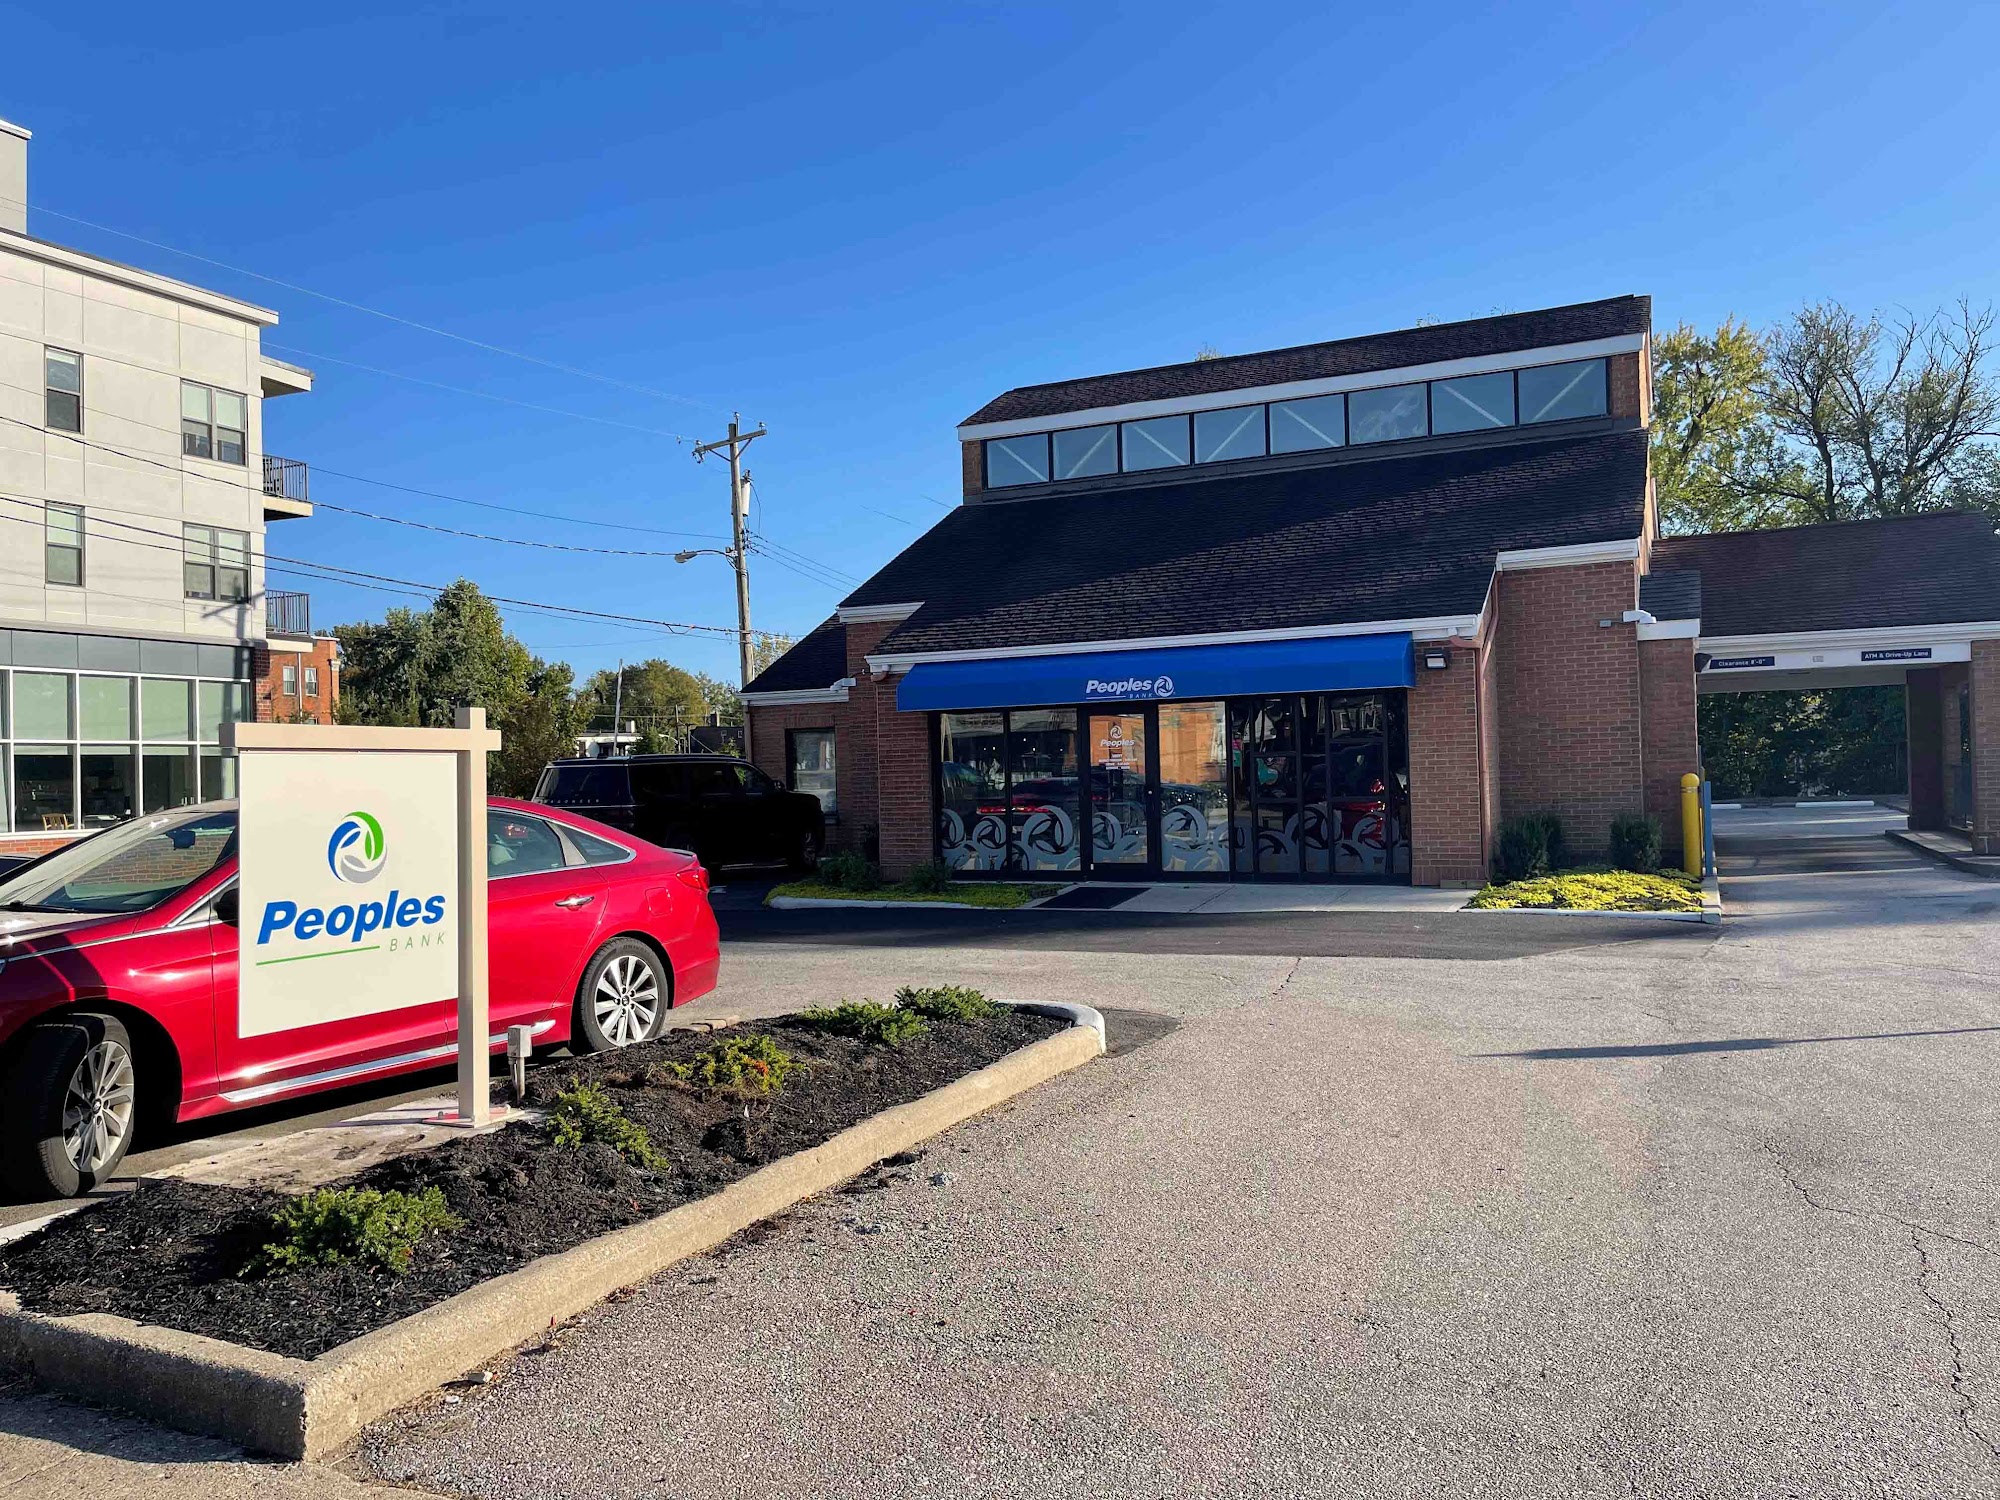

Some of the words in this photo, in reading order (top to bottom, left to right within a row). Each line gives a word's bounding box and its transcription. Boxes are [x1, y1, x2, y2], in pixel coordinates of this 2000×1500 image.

[1864, 652, 1878, 660] ATM
[1885, 650, 1912, 658] Drive-Up
[1718, 659, 1749, 667] Clearance
[1085, 677, 1153, 696] Peoples
[1100, 739, 1135, 748] Peoples
[257, 889, 446, 945] Peoples
[389, 932, 446, 952] BANK
